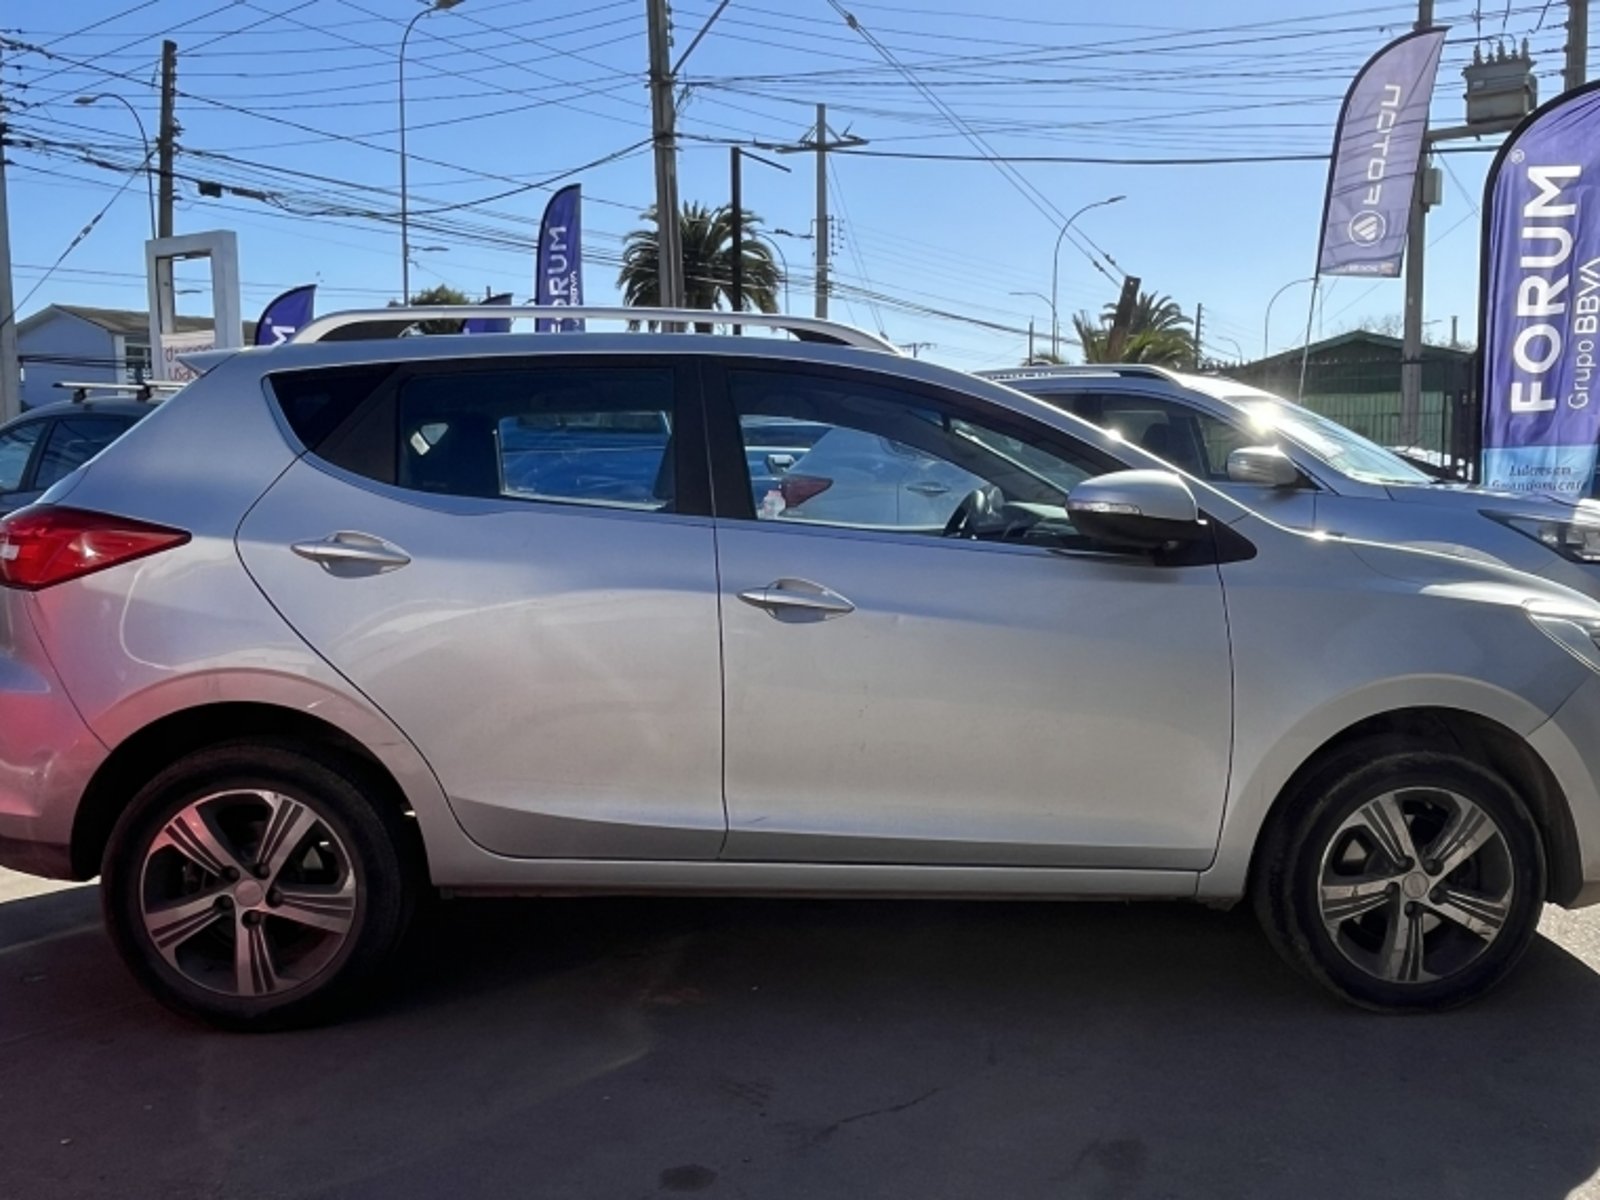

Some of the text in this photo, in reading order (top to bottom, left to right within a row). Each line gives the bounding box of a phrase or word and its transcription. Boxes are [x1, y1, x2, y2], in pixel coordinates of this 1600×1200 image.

[1510, 165, 1581, 414] FORUM
[1567, 257, 1600, 409] Grupo BBVA
